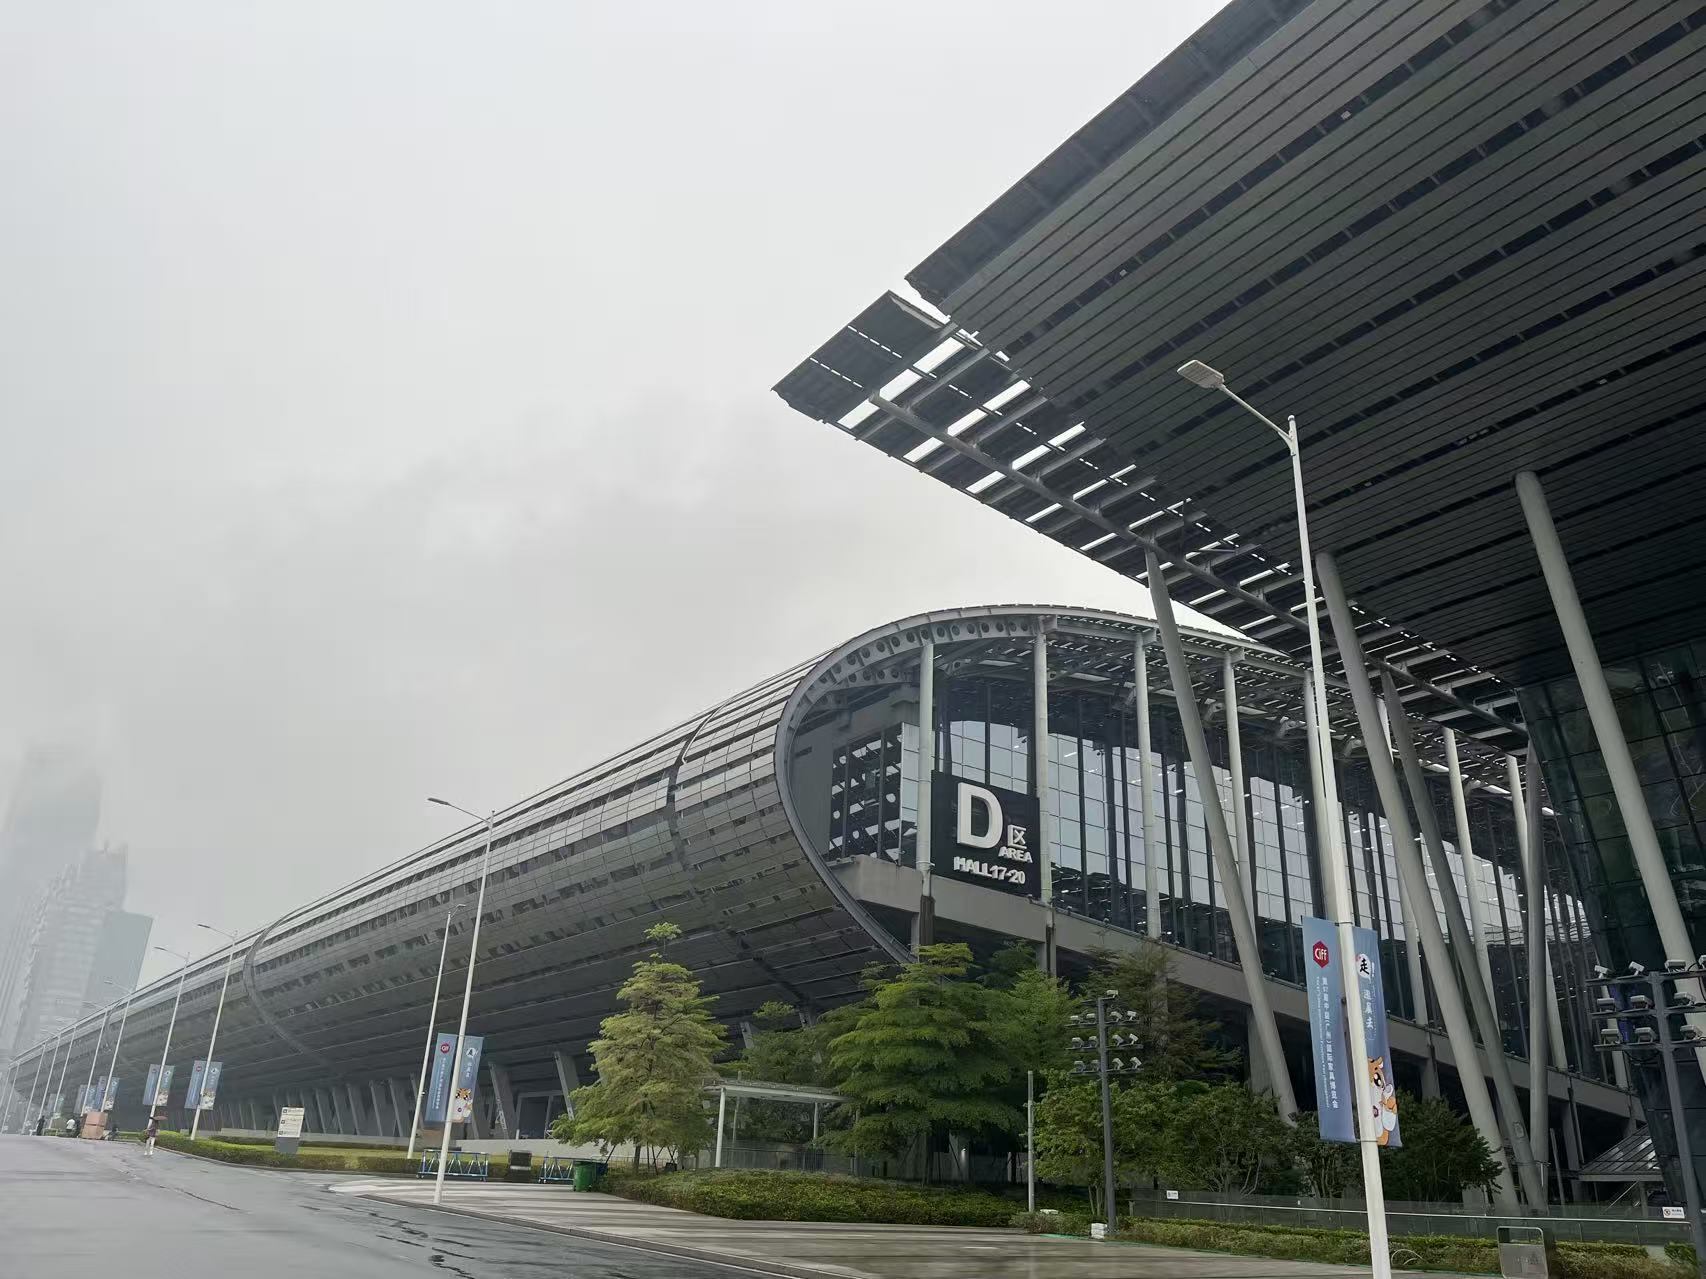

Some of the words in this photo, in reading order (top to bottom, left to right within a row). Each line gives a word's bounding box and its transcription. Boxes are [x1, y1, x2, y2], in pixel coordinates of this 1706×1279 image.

[957, 782, 1003, 849] D
[998, 846, 1033, 863] AREA
[953, 856, 992, 878] HALL
[990, 864, 1026, 885] 17-20
[1359, 958, 1370, 975] 走
